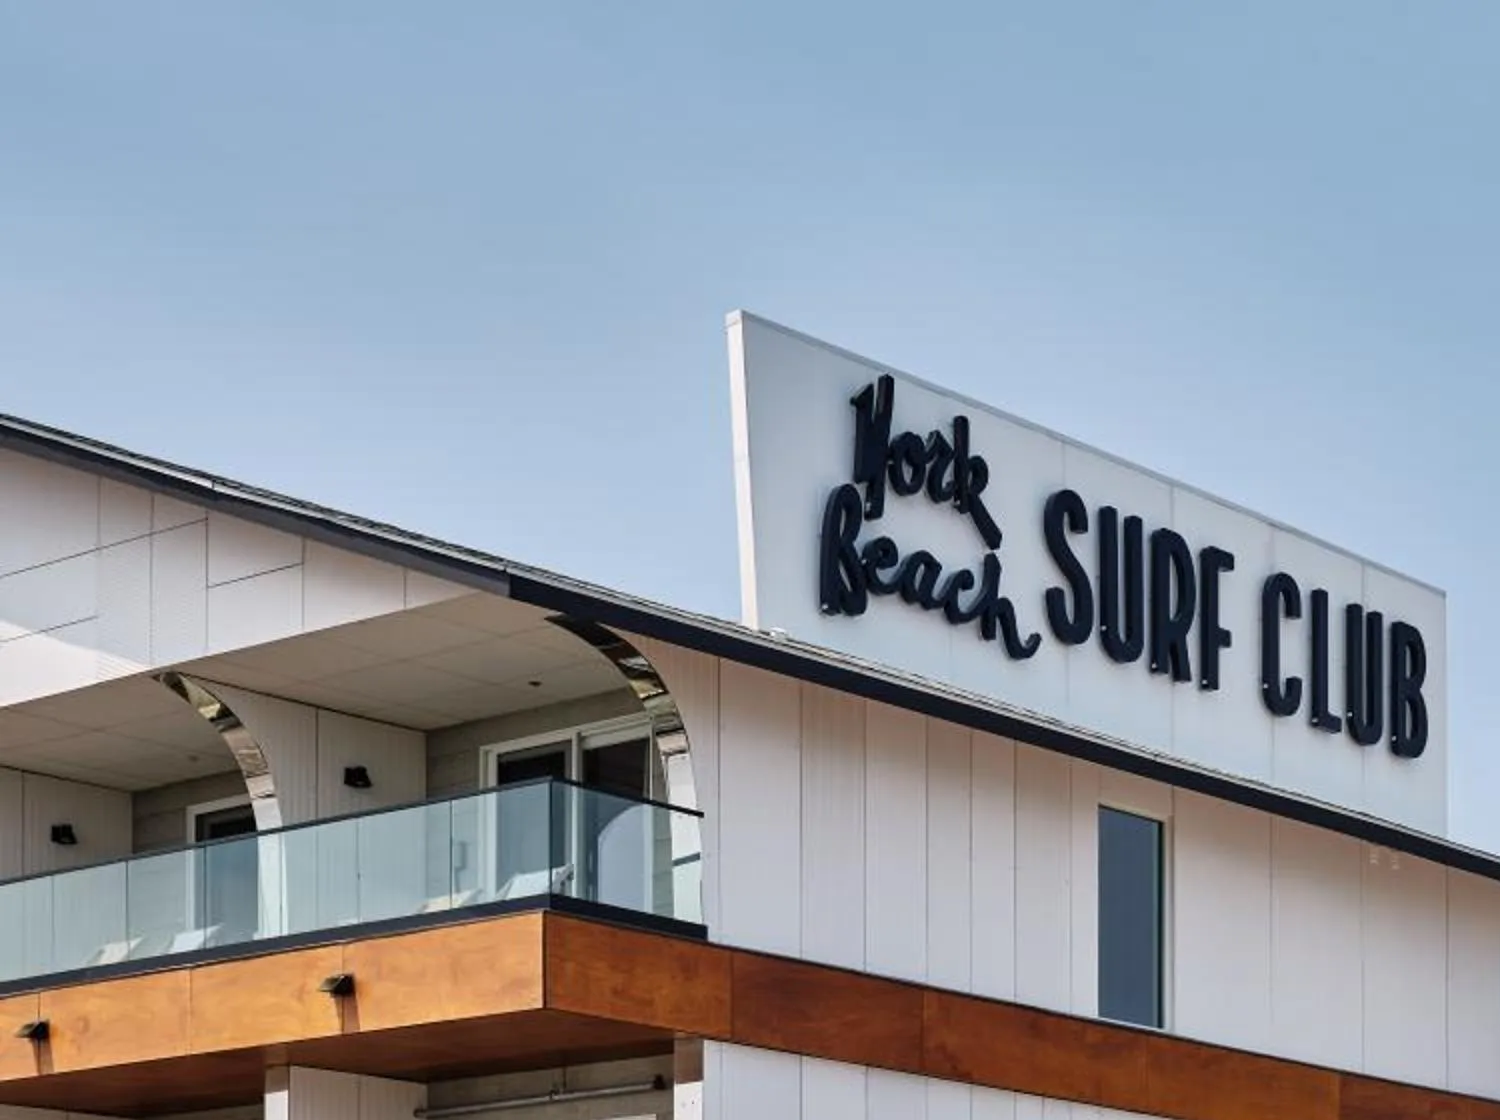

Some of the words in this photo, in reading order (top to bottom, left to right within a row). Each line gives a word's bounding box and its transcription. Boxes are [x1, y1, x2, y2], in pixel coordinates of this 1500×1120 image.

[849, 373, 1003, 550] York
[818, 482, 1041, 660] Beach
[1043, 489, 1236, 691] SURF
[1259, 571, 1430, 759] CLUB
